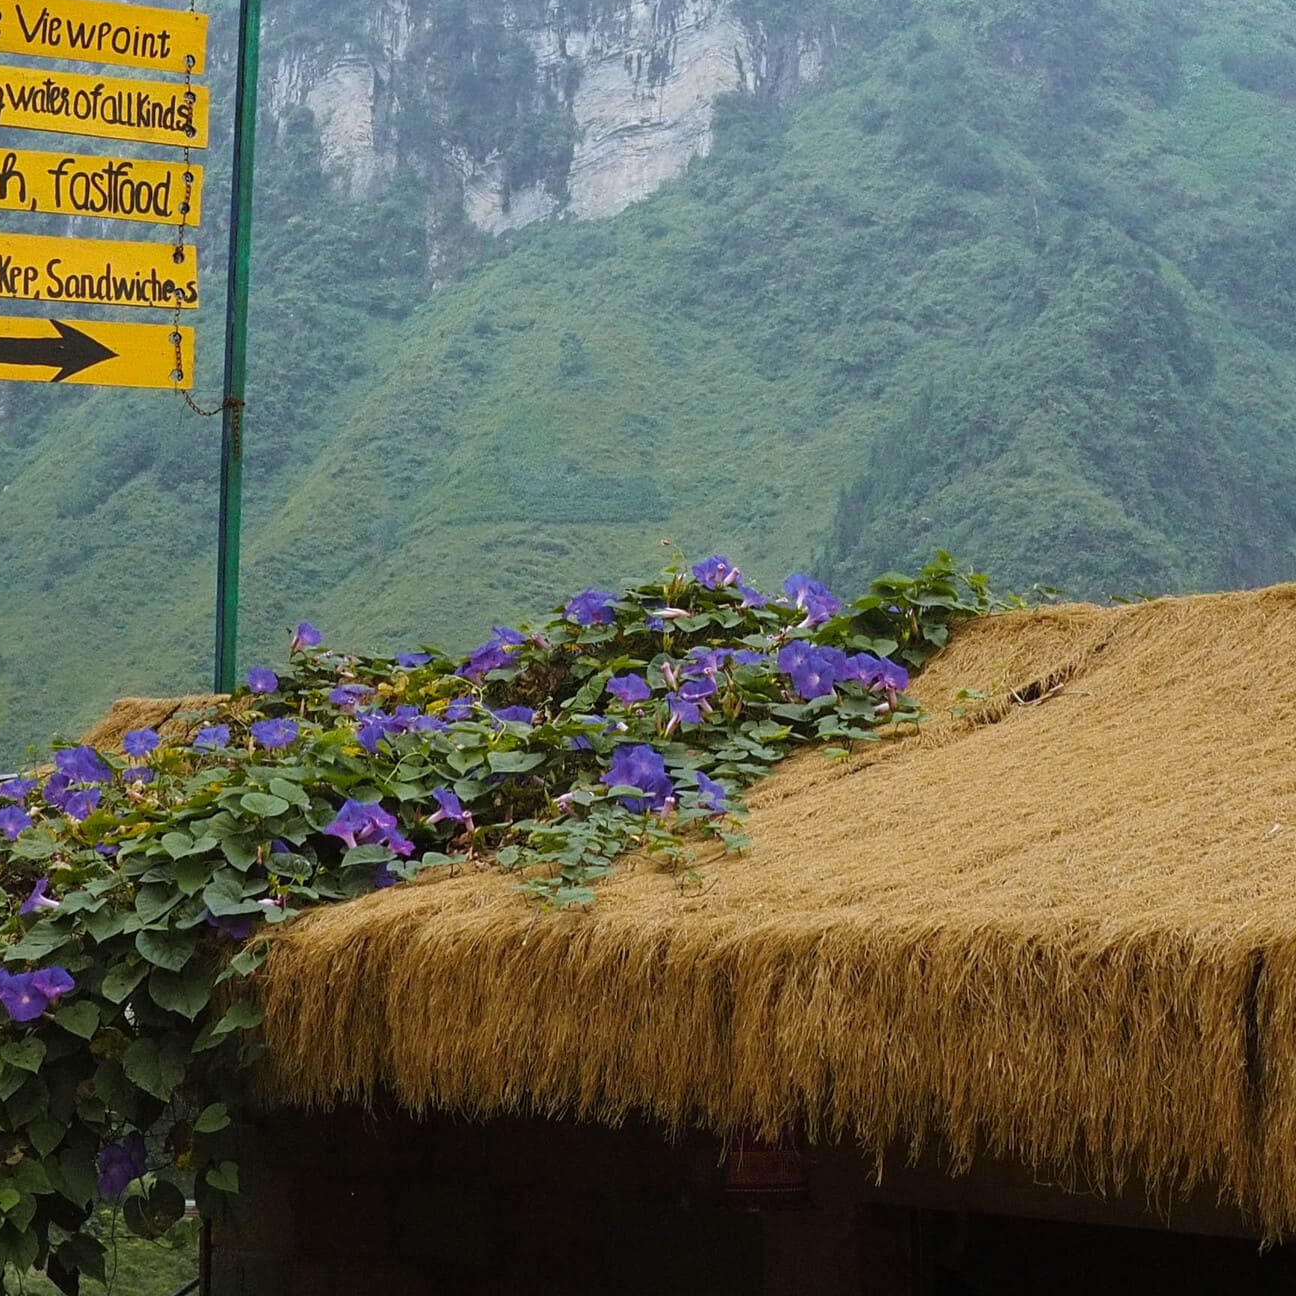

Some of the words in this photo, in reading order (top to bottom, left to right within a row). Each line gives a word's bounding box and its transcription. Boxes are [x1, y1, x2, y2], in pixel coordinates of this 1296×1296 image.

[5, 78, 71, 116] water
[73, 83, 104, 120] of
[101, 91, 135, 127] all
